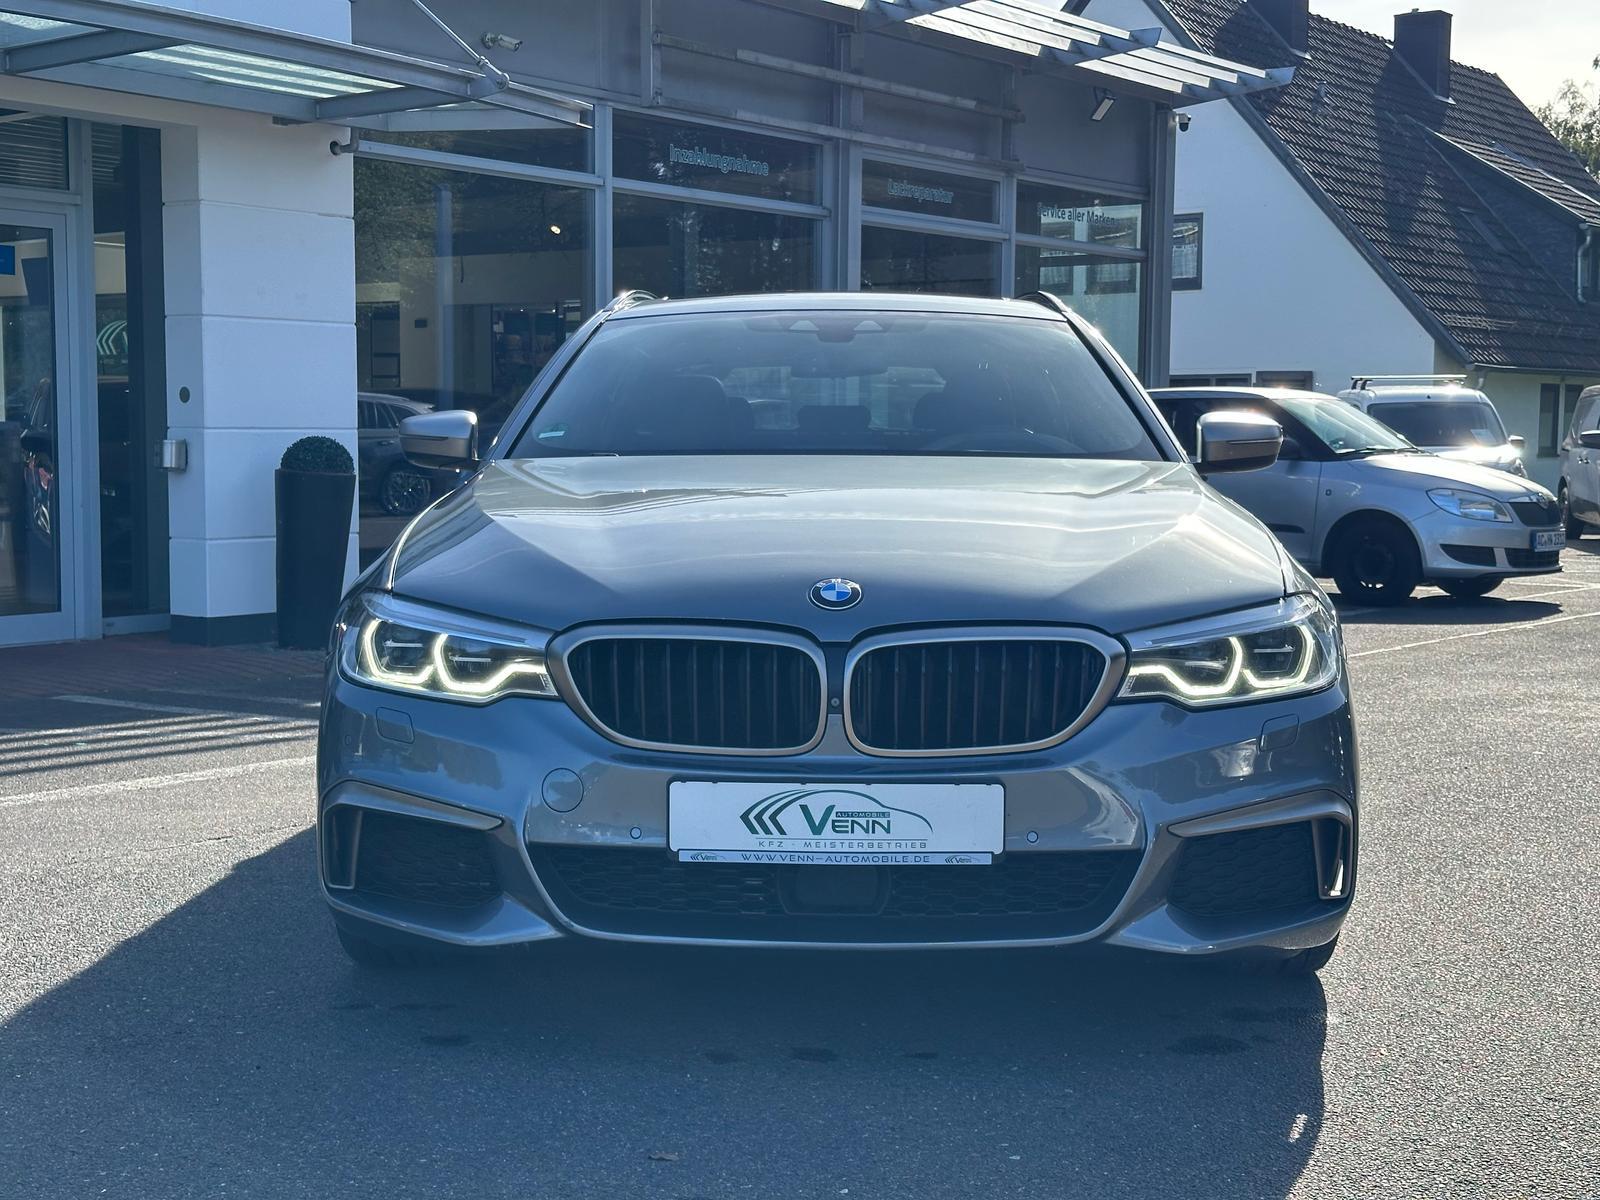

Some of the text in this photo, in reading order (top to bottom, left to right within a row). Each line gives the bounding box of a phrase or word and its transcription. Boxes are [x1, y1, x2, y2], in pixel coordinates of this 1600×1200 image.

[669, 143, 769, 176] Inzahlungnahme
[1067, 207, 1086, 223] aller
[1086, 210, 1115, 226] Marken
[799, 804, 891, 836] VENN
[803, 841, 927, 849] MEISTERBETRIEB
[741, 853, 930, 863] WWW.VENN-AUTOMOBILE.DE
